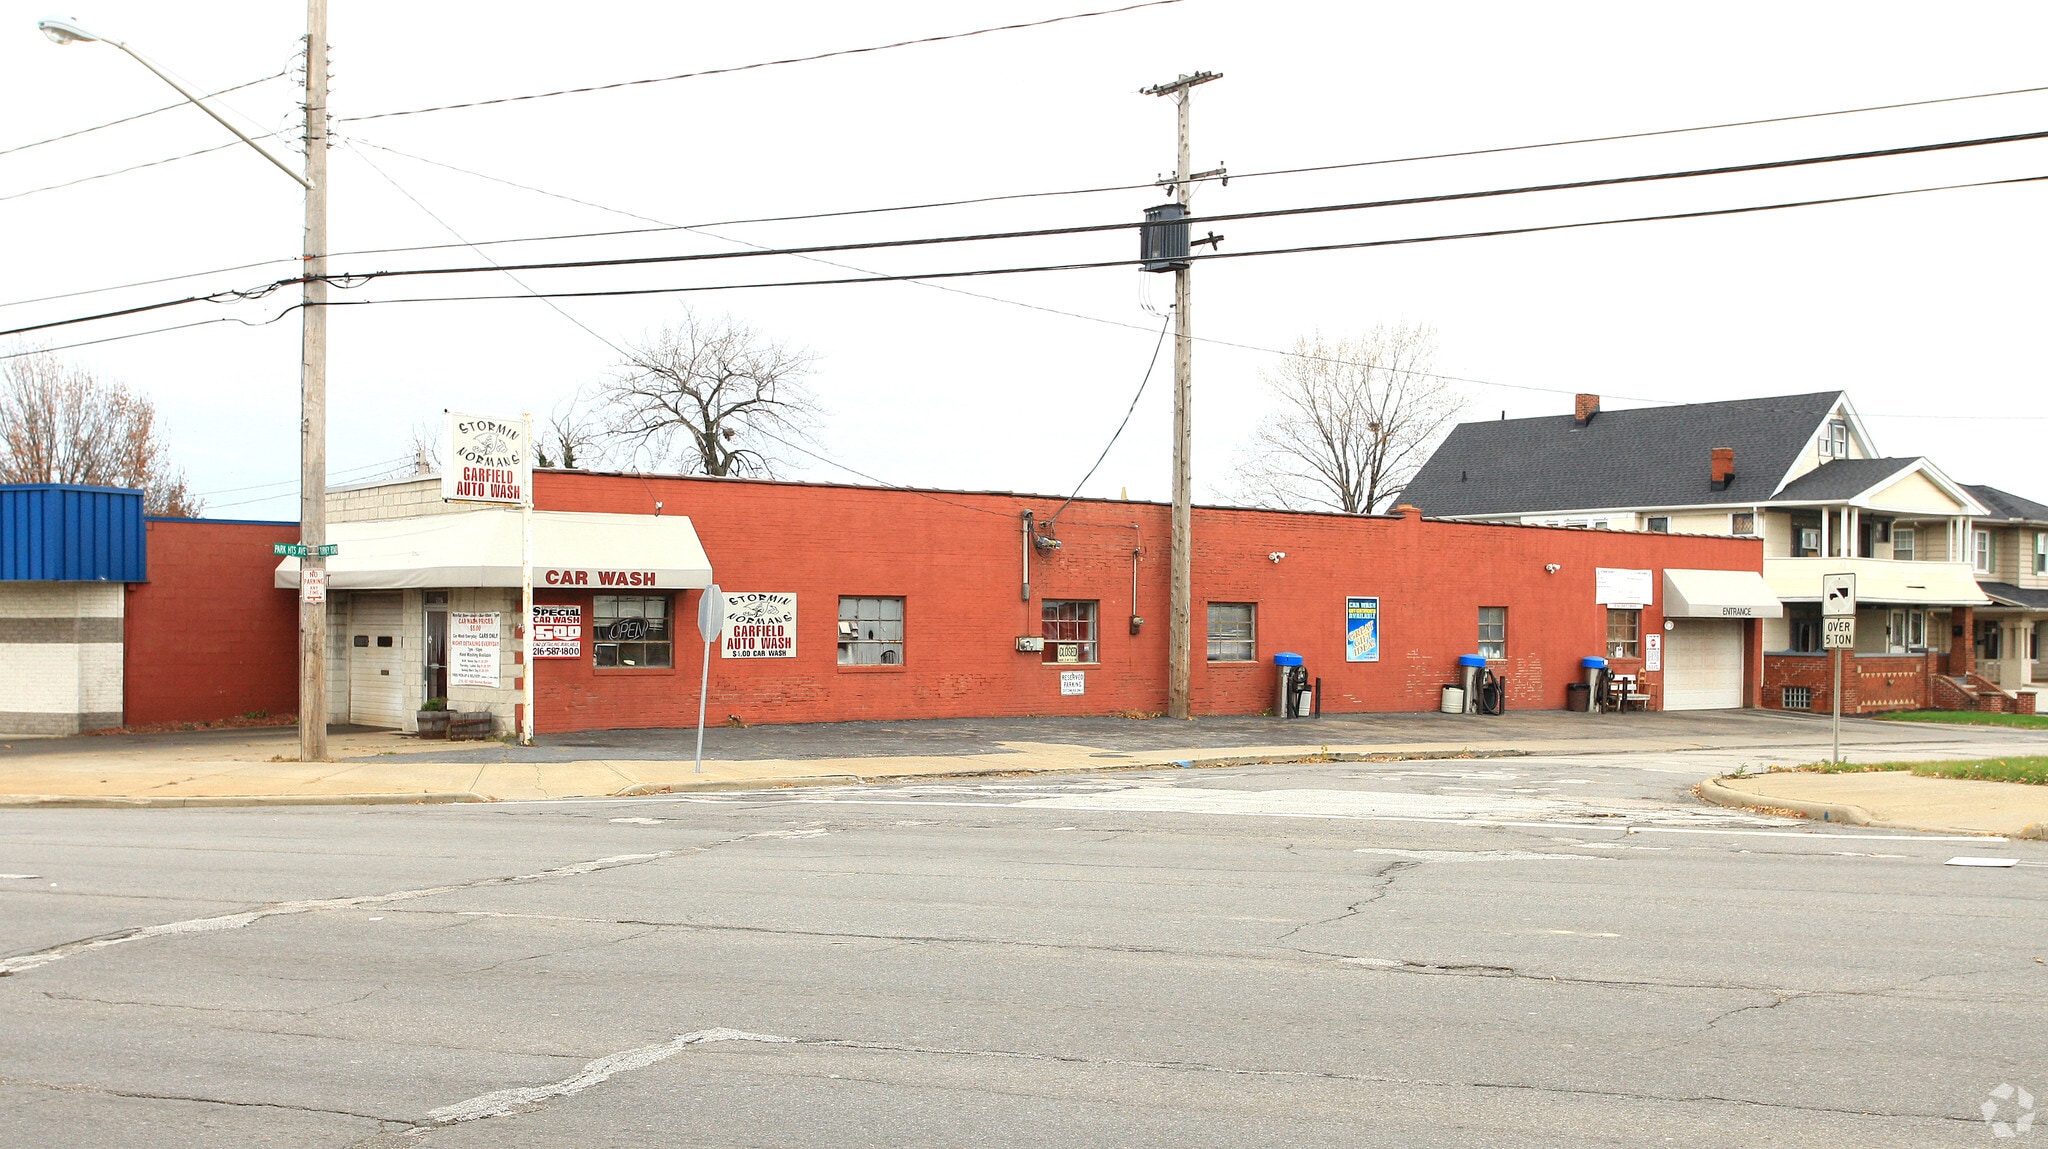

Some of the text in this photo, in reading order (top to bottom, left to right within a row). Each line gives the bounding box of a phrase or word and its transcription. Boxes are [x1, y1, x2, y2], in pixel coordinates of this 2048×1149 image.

[458, 420, 519, 440] STORMIN
[463, 466, 513, 484] GARFIELD
[456, 481, 520, 499] AUTO WASH
[274, 544, 307, 556] PARK HTS AVE
[545, 569, 656, 586] CAR WASH
[728, 593, 792, 605] STORMIN
[532, 606, 581, 616] SPECIAL
[1722, 607, 1752, 616] ENTRANCE
[610, 621, 646, 639] OPEN
[733, 625, 784, 637] GARFIELD
[1348, 620, 1374, 641] GREAT
[1827, 621, 1851, 632] OVER
[726, 637, 792, 650] AUTO WASH
[1353, 632, 1372, 648] GIFT
[1825, 634, 1852, 645] 5 TON
[1058, 646, 1078, 657] CLOSED
